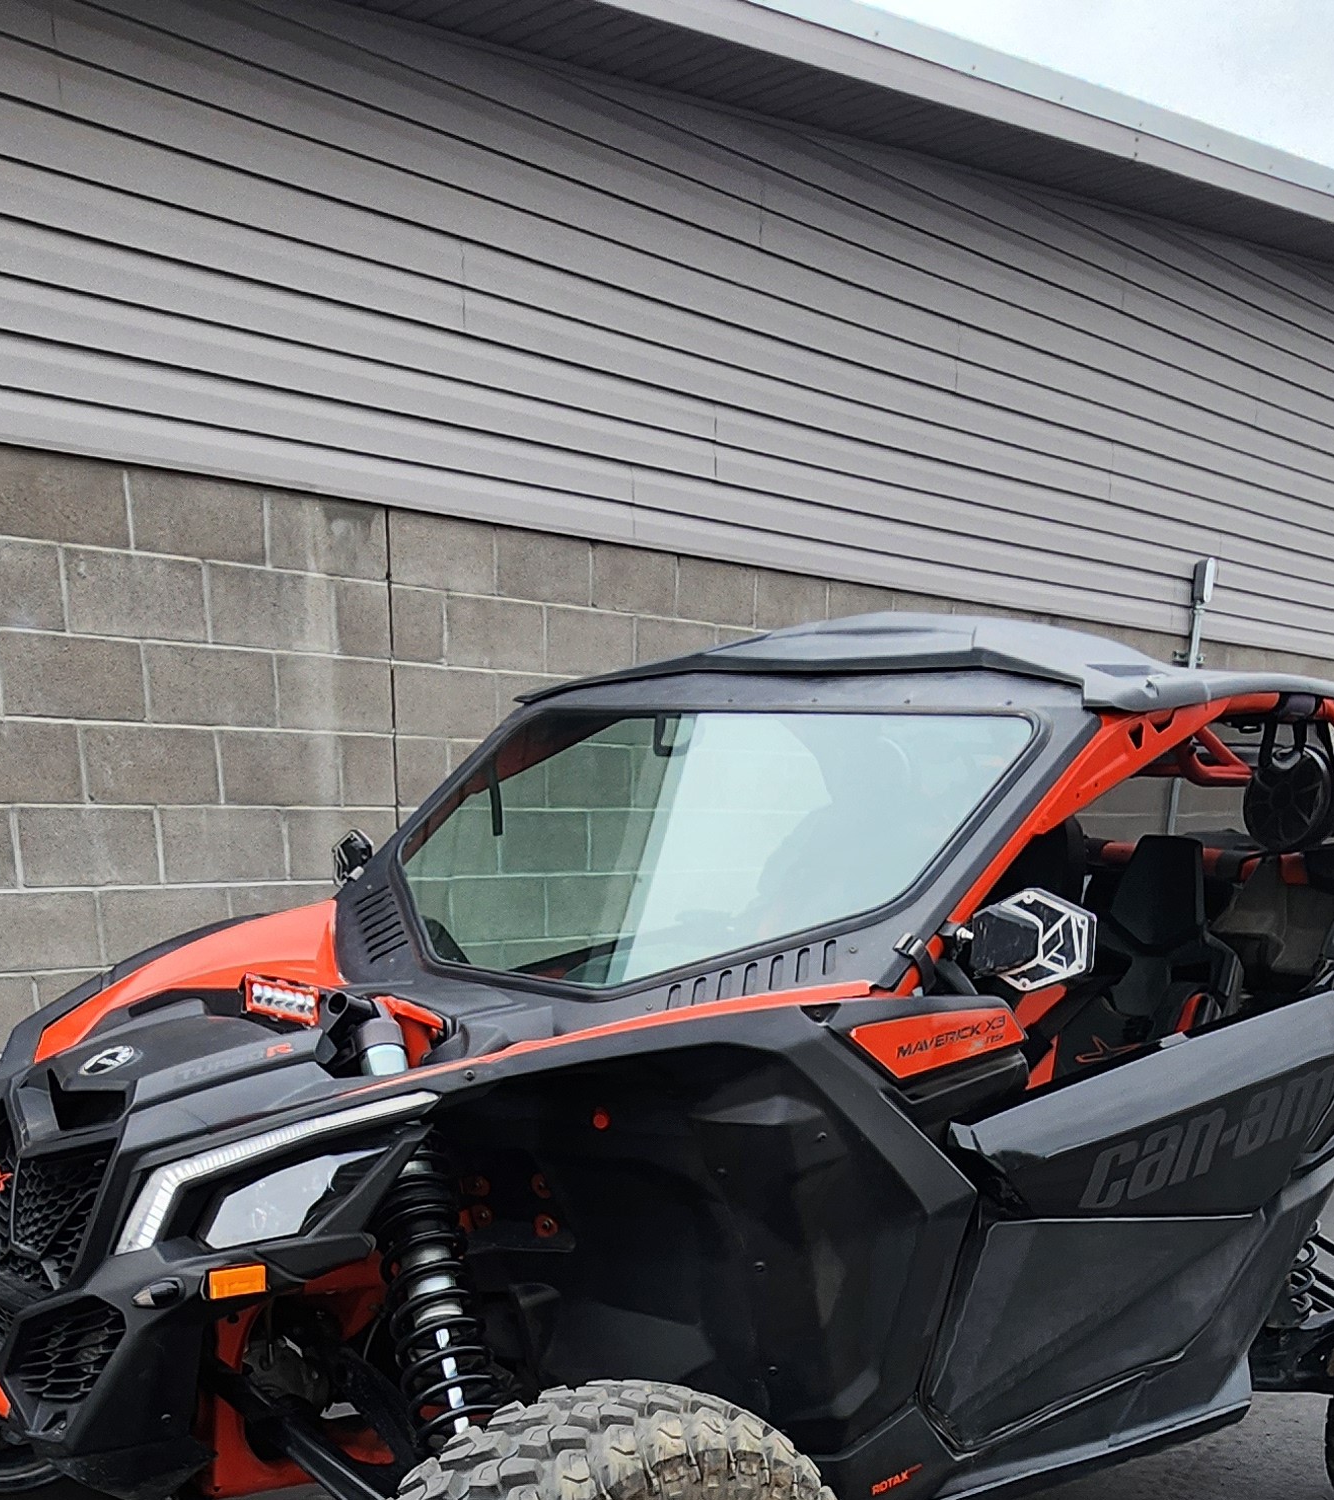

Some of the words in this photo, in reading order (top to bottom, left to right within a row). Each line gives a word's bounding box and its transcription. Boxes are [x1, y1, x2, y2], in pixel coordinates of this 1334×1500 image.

[896, 1023, 981, 1059] MAVERICK
[984, 1015, 1006, 1034] X3
[872, 1470, 909, 1496] ROTAX
